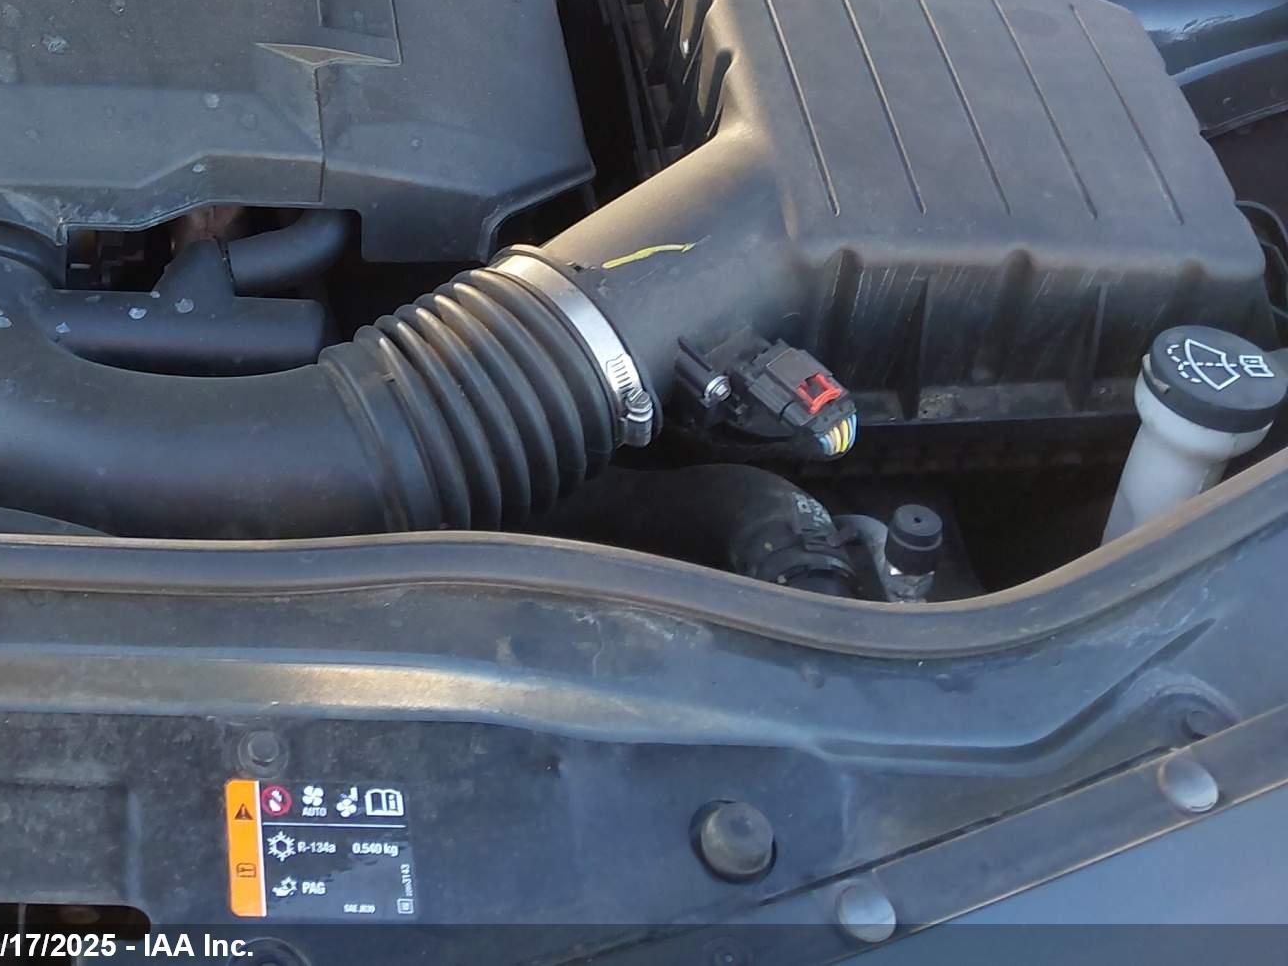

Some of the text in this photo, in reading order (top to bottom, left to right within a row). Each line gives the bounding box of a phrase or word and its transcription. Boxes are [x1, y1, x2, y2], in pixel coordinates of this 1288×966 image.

[301, 806, 328, 818] AUTO
[297, 841, 337, 854] R-134a
[383, 842, 399, 857] kg
[301, 881, 327, 895] PAG
